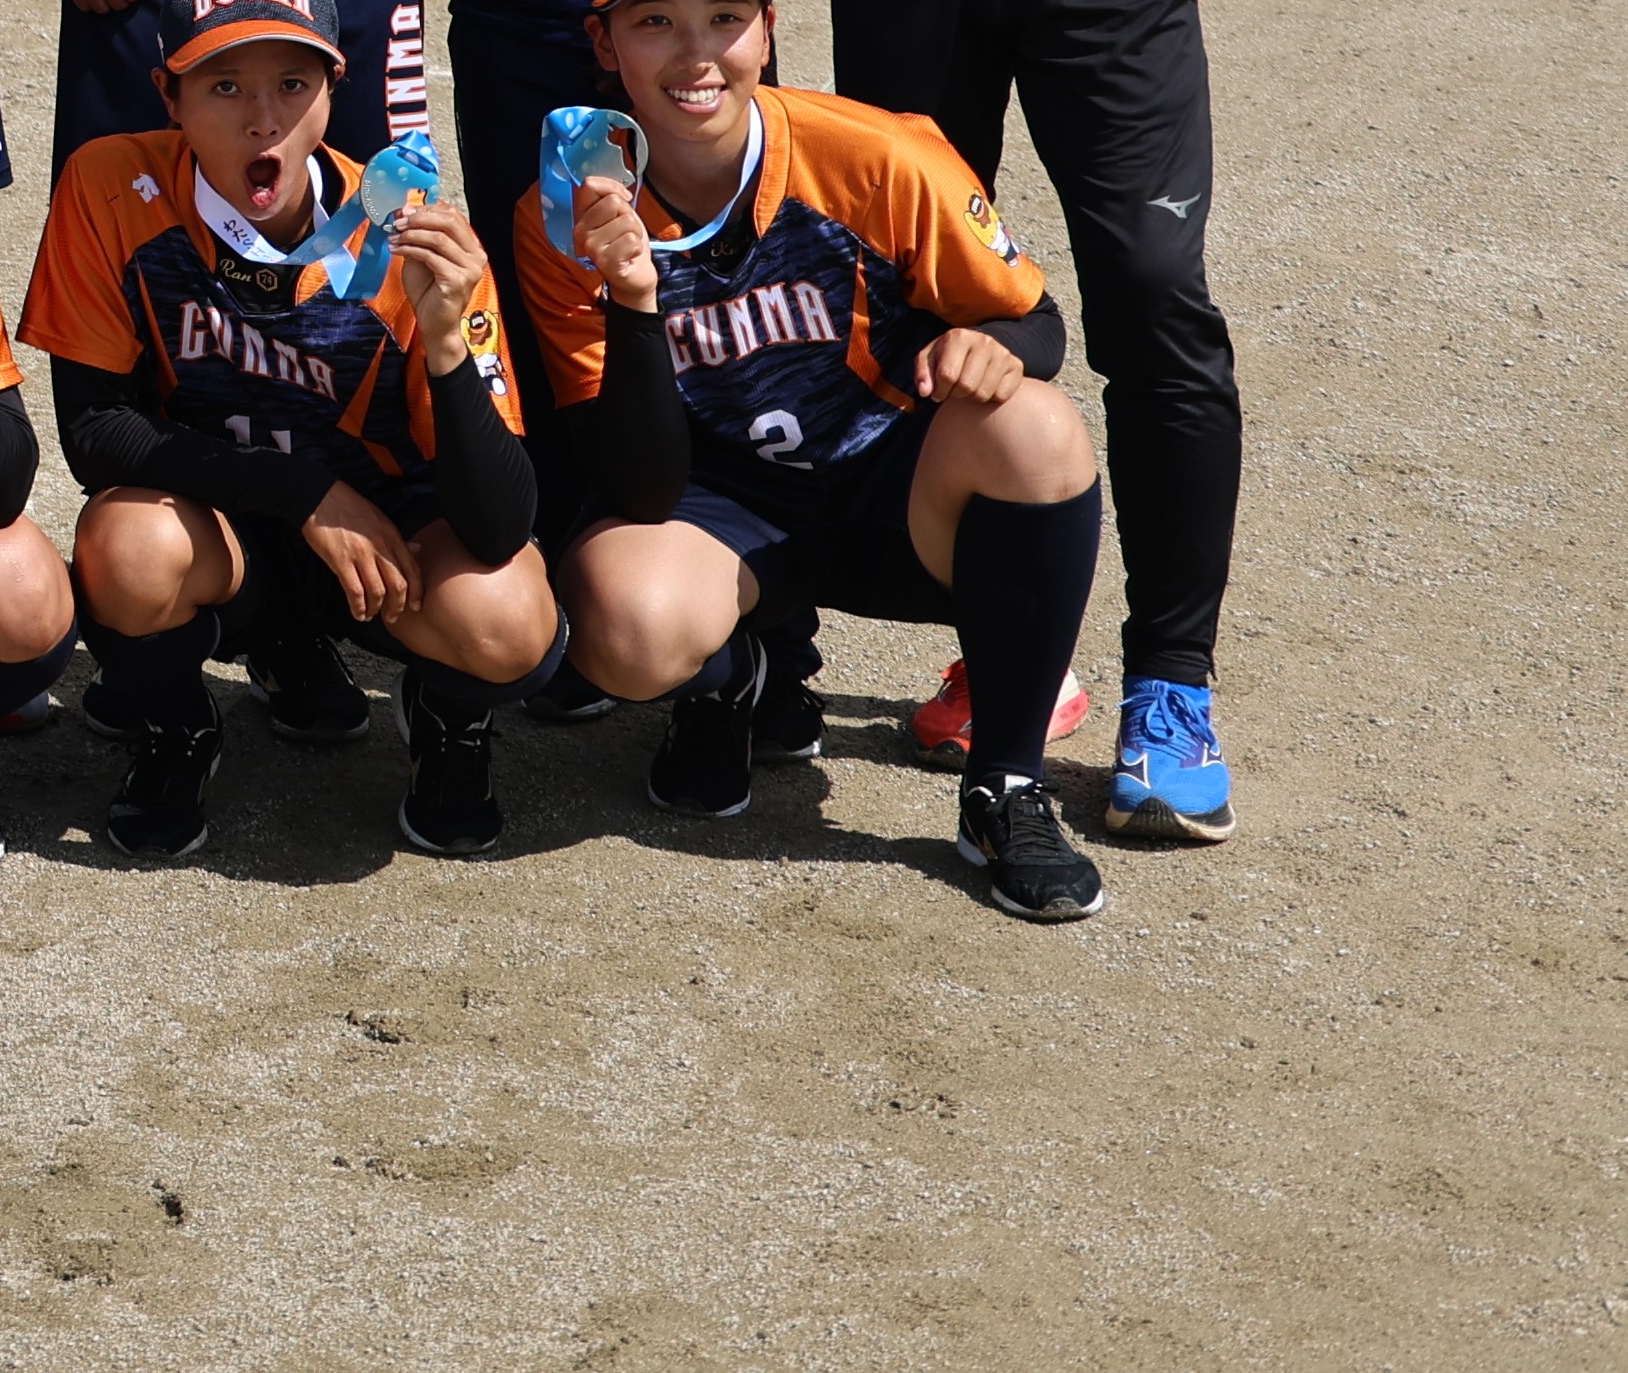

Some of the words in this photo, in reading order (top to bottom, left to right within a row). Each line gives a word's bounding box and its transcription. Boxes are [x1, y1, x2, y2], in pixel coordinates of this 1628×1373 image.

[385, 3, 430, 141] UNMA
[176, 299, 338, 402] GUNMA
[665, 279, 842, 376] GUNMA
[748, 409, 814, 471] 2
